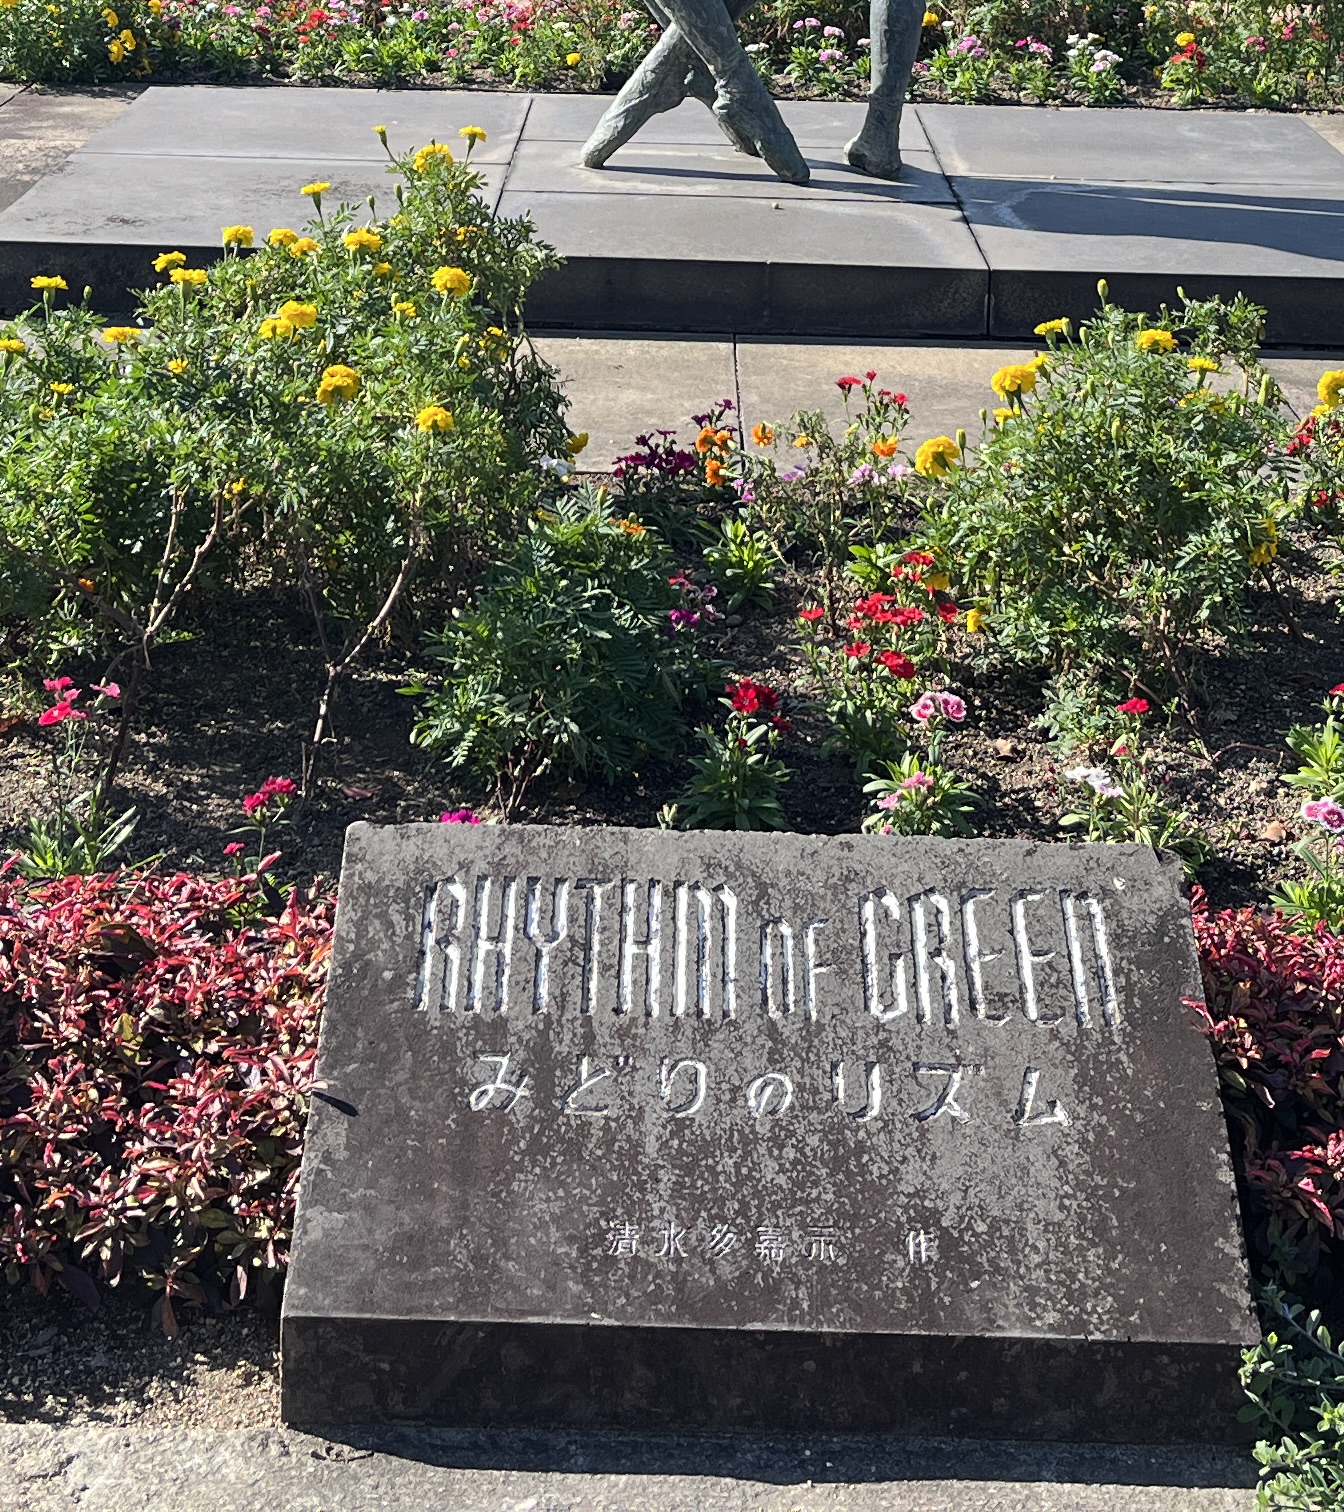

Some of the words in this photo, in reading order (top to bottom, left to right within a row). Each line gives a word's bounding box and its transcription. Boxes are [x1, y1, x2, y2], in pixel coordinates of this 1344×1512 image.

[412, 874, 738, 1020] RHYTHM
[759, 917, 837, 1022] OF
[857, 886, 1121, 1029] GREEN
[469, 1050, 1072, 1127] みどりのリズム
[607, 1220, 836, 1262] 清水多嘉示
[906, 1228, 935, 1264] 作
